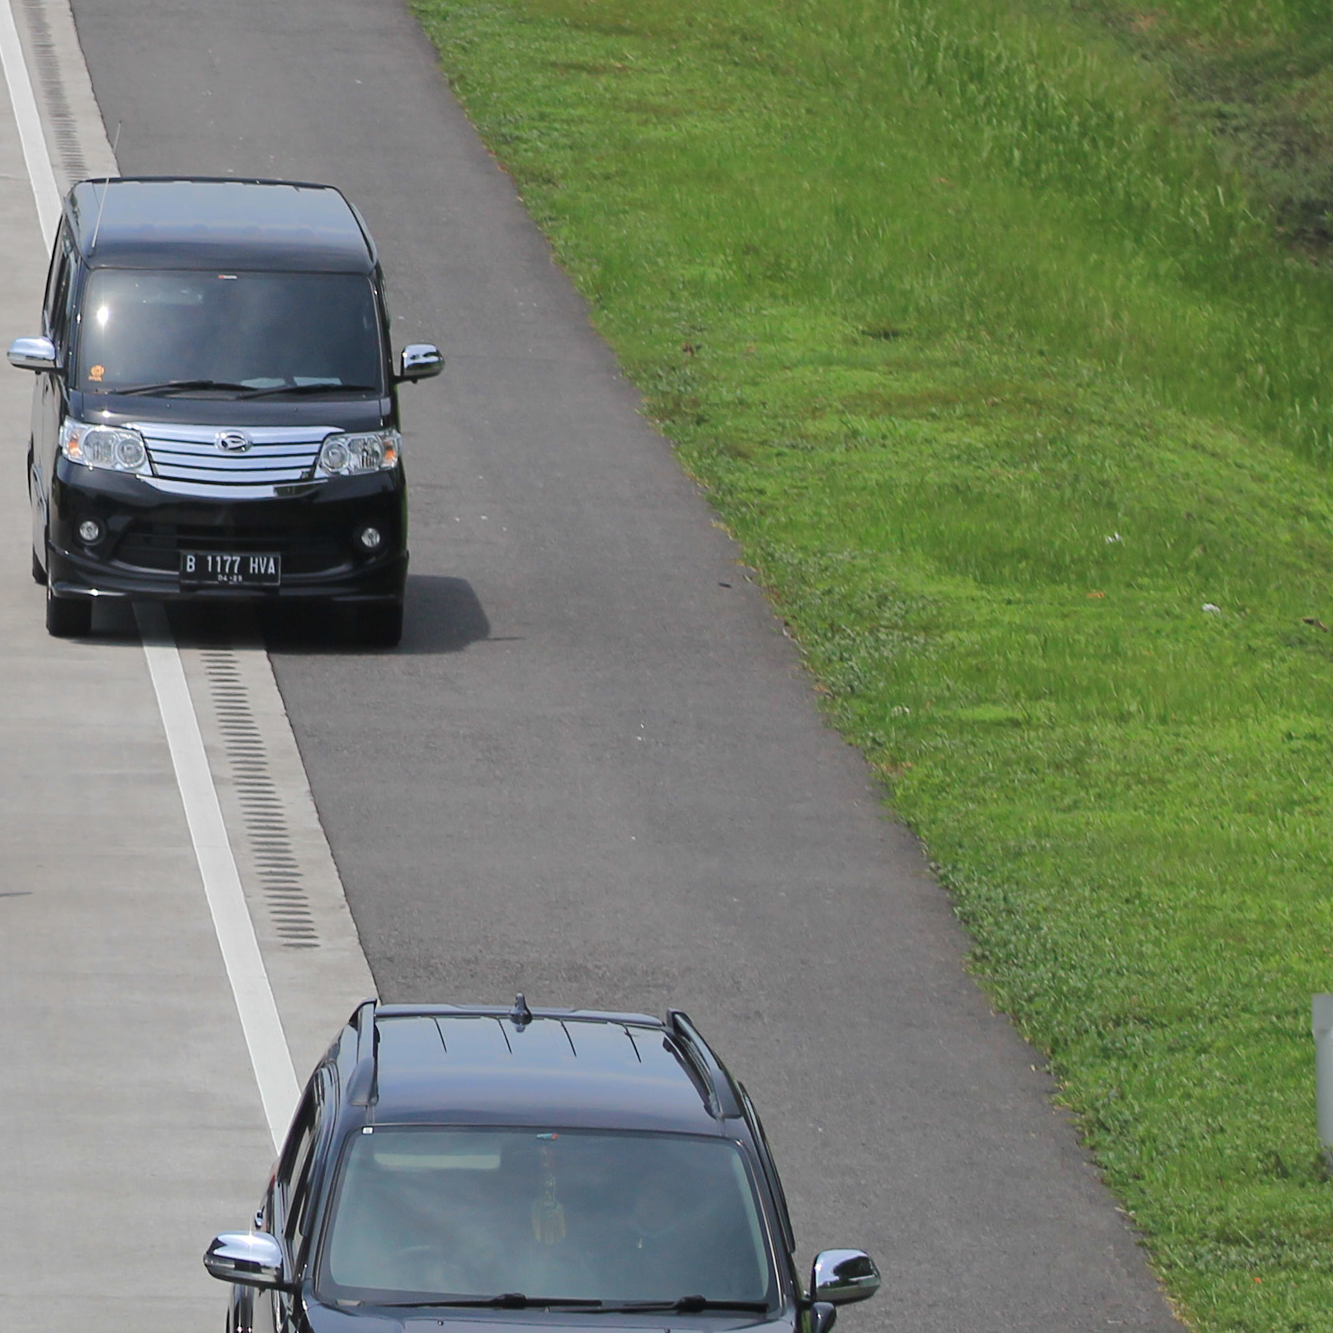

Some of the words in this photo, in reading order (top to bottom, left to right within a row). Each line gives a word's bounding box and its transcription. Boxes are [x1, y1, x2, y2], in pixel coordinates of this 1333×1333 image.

[186, 555, 196, 572] B
[207, 555, 241, 574] 1177
[249, 556, 275, 574] HVA
